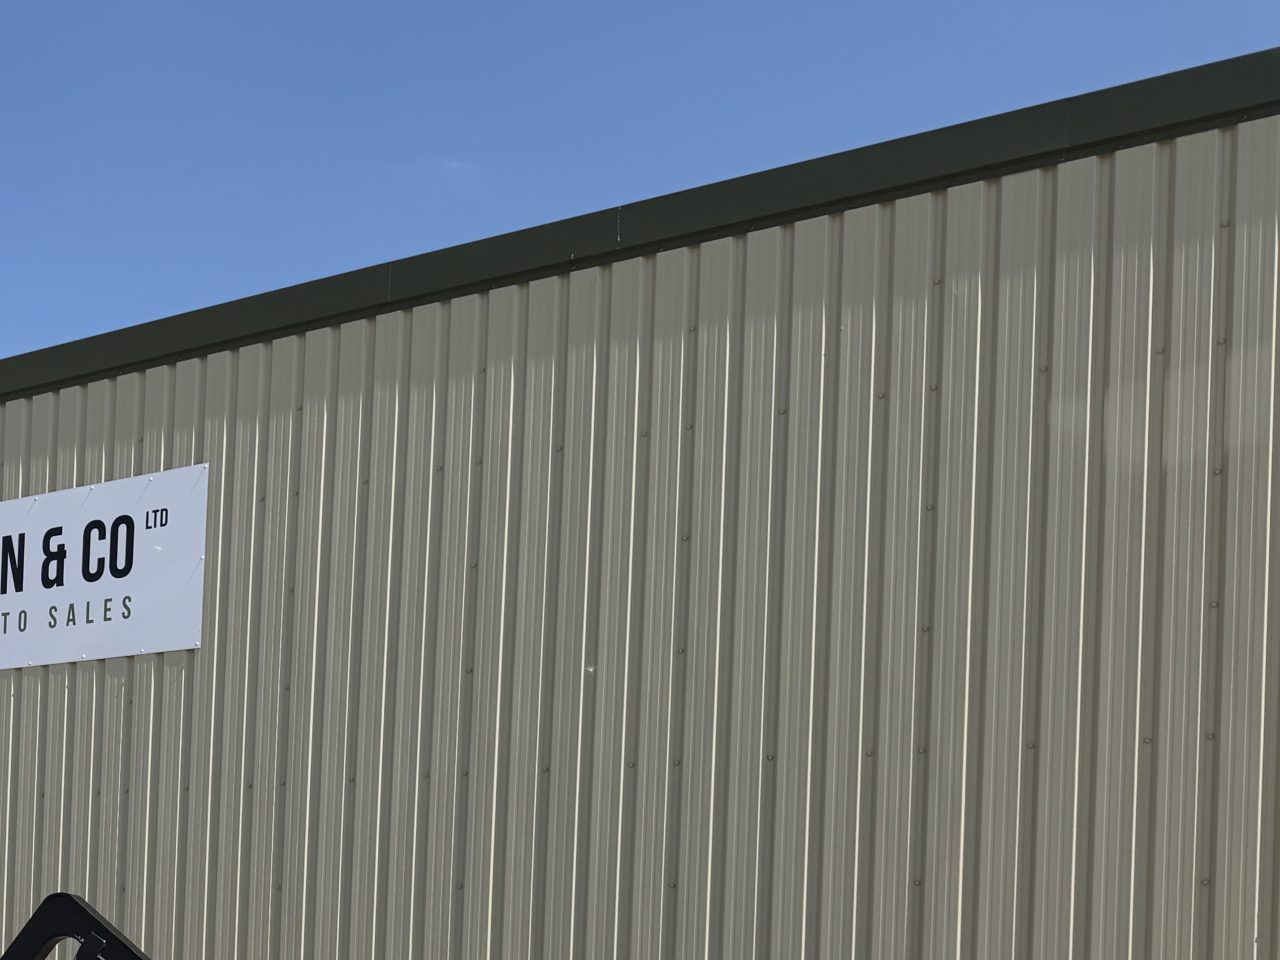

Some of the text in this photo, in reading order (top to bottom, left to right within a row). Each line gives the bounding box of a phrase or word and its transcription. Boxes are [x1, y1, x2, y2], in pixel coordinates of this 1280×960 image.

[144, 507, 170, 530] LTD
[40, 525, 68, 590] &
[81, 514, 136, 583] CO
[48, 595, 132, 629] SALES
